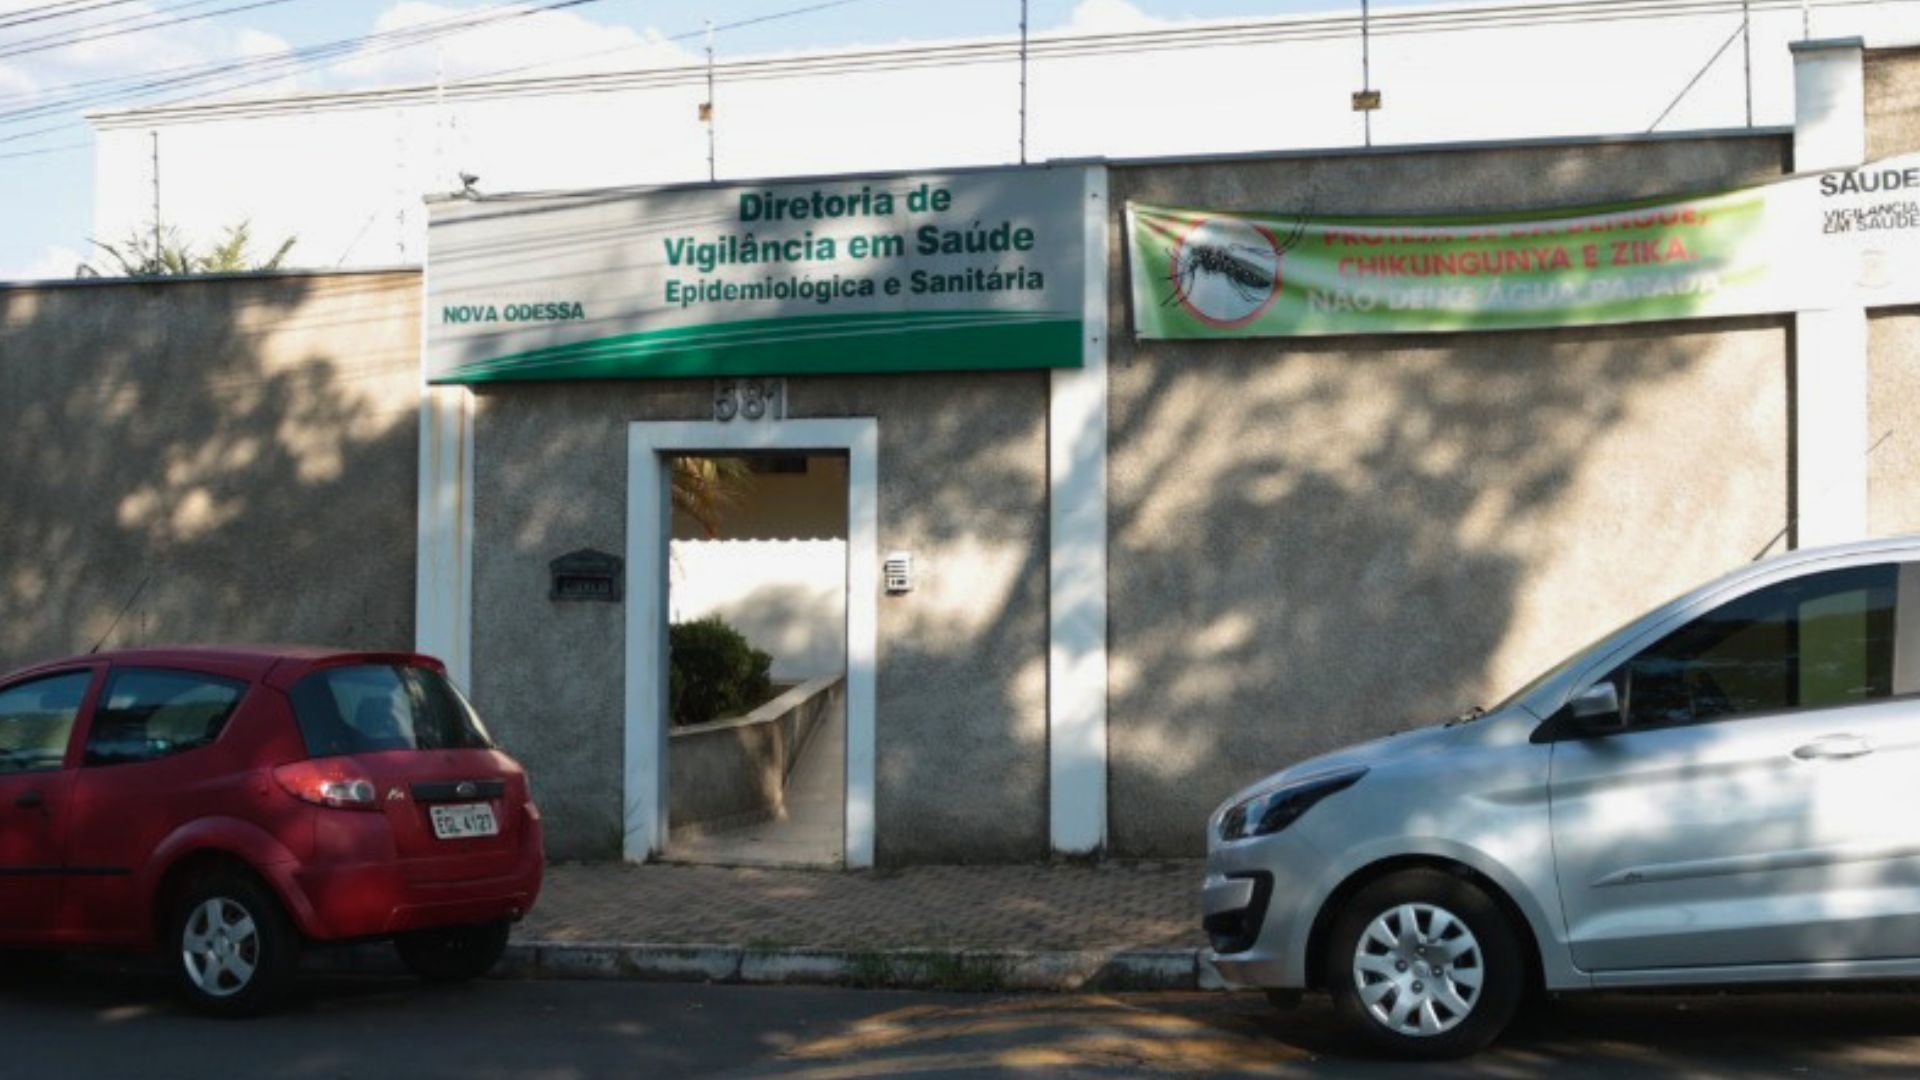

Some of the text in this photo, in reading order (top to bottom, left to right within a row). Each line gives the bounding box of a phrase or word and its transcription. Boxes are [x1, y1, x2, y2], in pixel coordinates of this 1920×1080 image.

[739, 184, 951, 222] Diretoria de
[664, 220, 1035, 273] Vigilância em Saúde
[1339, 245, 1572, 279] CHIKUNGUNYA
[1582, 243, 1598, 268] E
[665, 265, 1045, 308] Epidemiológica e Sanitária
[442, 301, 585, 324] NOVA ODESSA
[714, 383, 784, 422] 581
